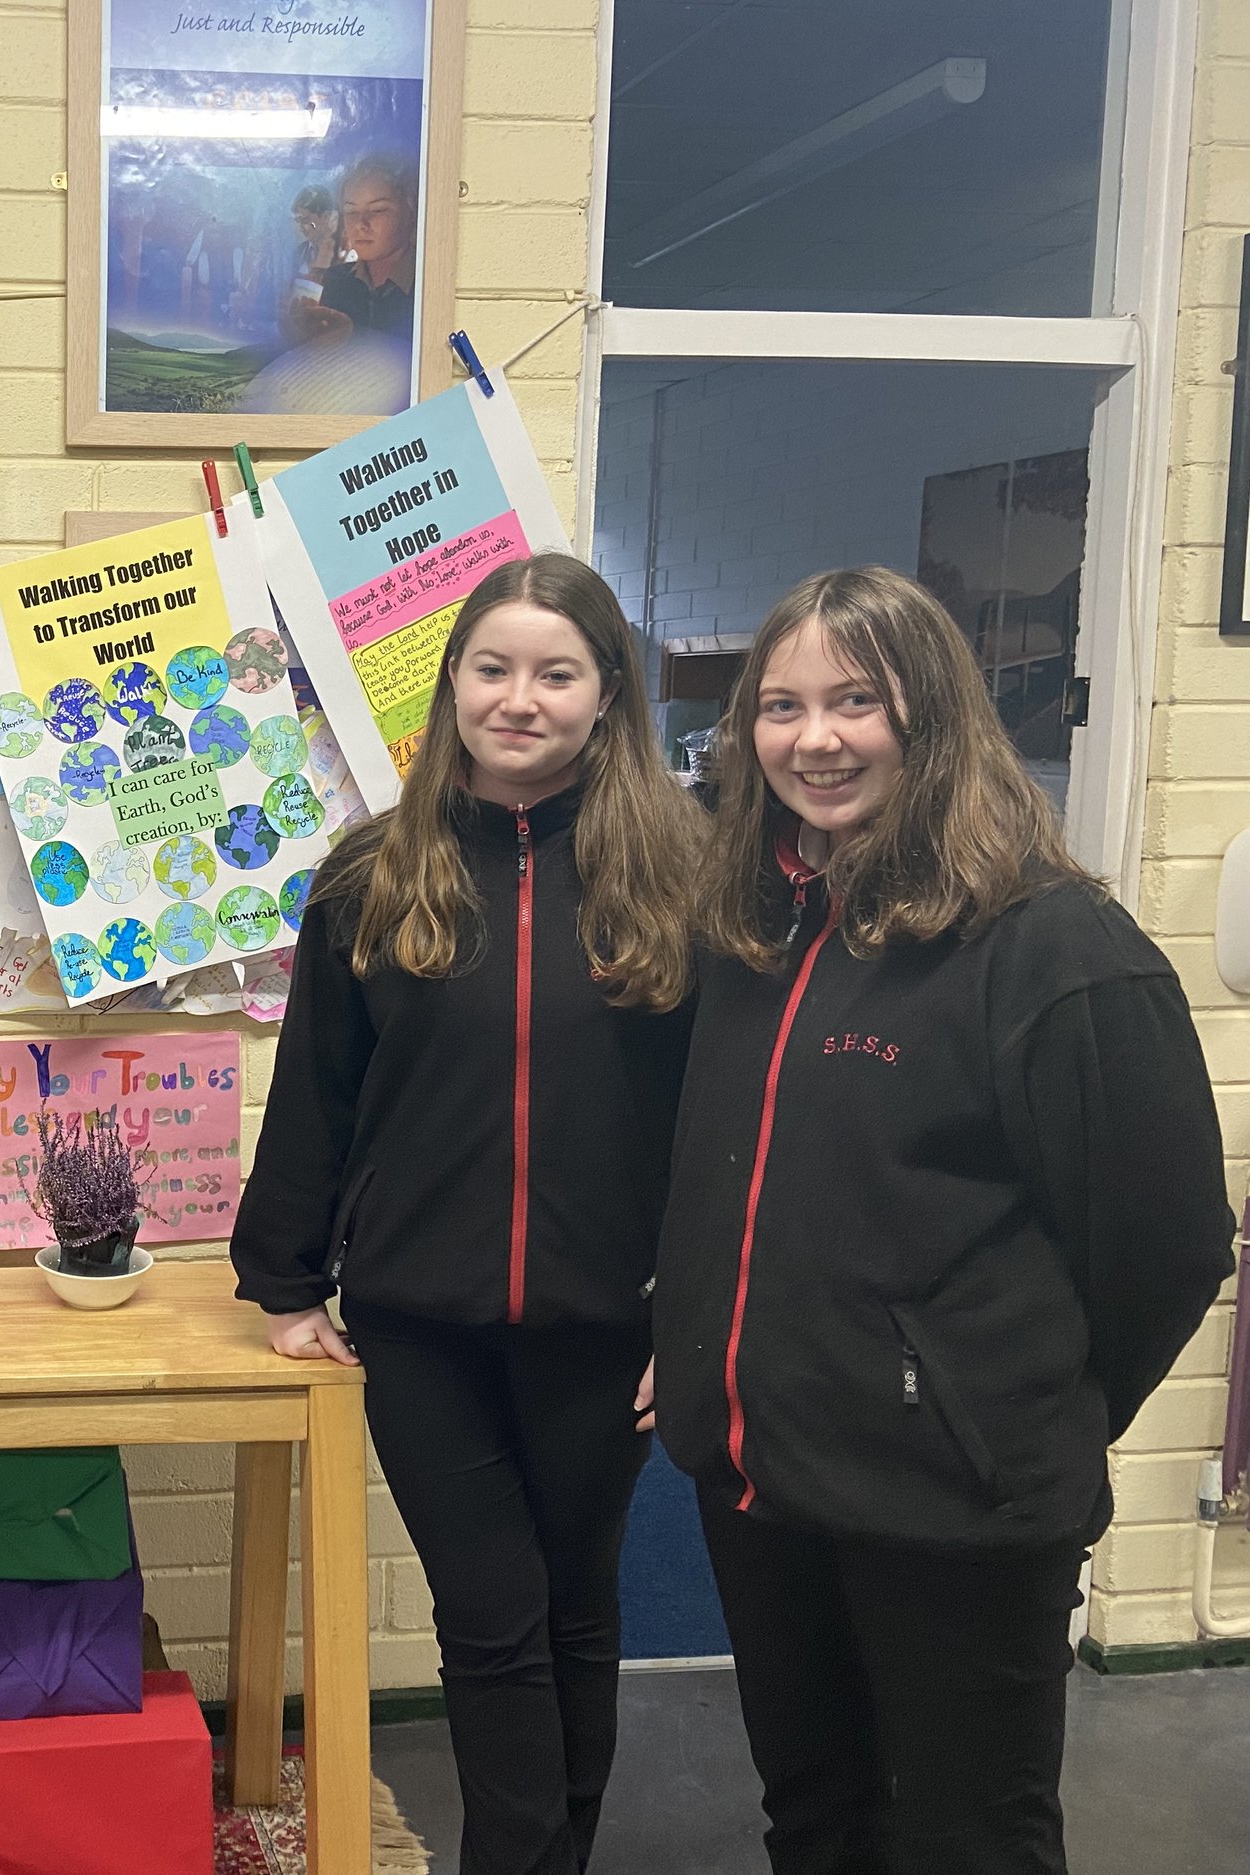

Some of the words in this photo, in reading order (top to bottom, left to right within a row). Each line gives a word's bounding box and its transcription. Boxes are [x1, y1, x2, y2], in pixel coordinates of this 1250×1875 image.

[171, 13, 211, 34] Just
[217, 13, 254, 33] and
[261, 16, 366, 44] Responsible
[338, 437, 429, 495] Walking
[338, 484, 433, 542] Together
[434, 466, 460, 493] in
[385, 521, 442, 564] Hope
[18, 570, 103, 610] Walking
[104, 548, 194, 588] Together
[334, 603, 352, 618] We
[353, 588, 379, 609] must
[380, 576, 397, 594] not
[399, 568, 412, 583] let
[415, 556, 439, 577] hope
[440, 536, 477, 560] abandon
[340, 611, 373, 635] because
[399, 586, 418, 604] with
[462, 549, 489, 569] walks
[490, 536, 514, 554] with
[33, 623, 56, 644] to
[57, 597, 162, 638] Transform
[164, 586, 197, 611] our
[93, 631, 155, 666] World
[356, 653, 379, 667] May
[378, 642, 395, 656] the
[441, 613, 451, 622] us
[176, 669, 194, 684] Be
[197, 663, 223, 679] Kind
[362, 668, 379, 681] this
[401, 635, 437, 657] between
[390, 666, 404, 681] you
[405, 646, 442, 673] forward
[378, 693, 397, 708] And
[400, 681, 421, 696] there
[423, 672, 437, 685] will
[256, 741, 291, 756] RECYCLE
[108, 782, 117, 797] I
[121, 777, 149, 793] can
[153, 768, 187, 786] care
[190, 760, 215, 778] for
[280, 783, 312, 798] Reduce
[116, 798, 166, 822] Earth,
[284, 801, 308, 812] Reuse
[285, 812, 318, 828] Recycle
[125, 819, 194, 845] creation,
[197, 813, 223, 832] by:
[9, 974, 21, 986] at
[13, 956, 29, 972] Get
[27, 1043, 107, 1098] Your
[102, 1050, 238, 1096] Troubles
[65, 1104, 118, 1131] and
[123, 1103, 208, 1147] your
[197, 1137, 238, 1160] and
[168, 1201, 231, 1227] your
